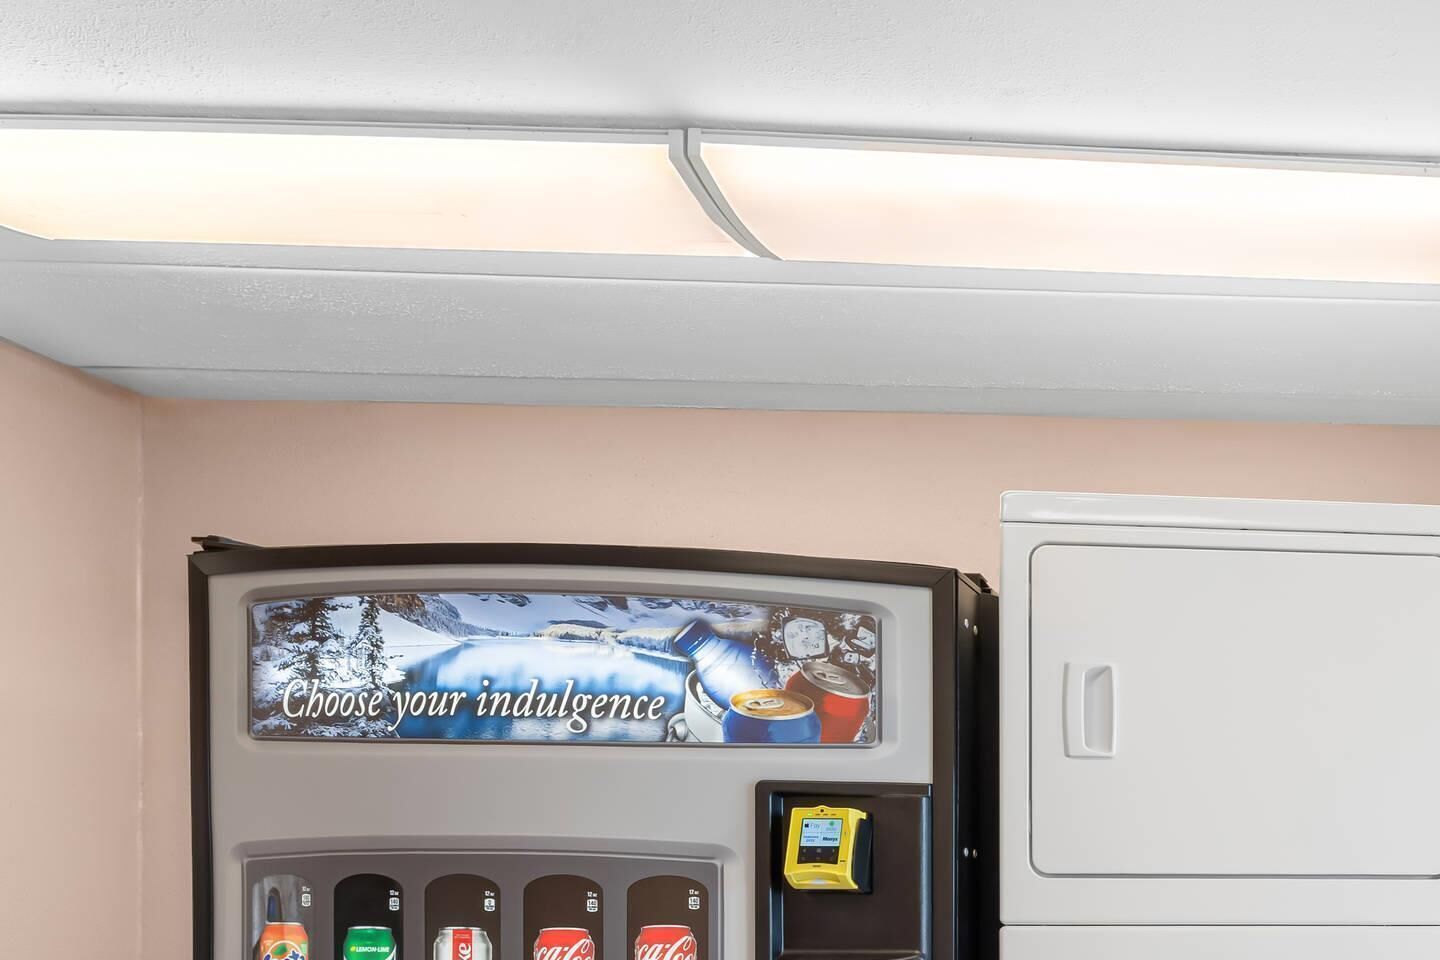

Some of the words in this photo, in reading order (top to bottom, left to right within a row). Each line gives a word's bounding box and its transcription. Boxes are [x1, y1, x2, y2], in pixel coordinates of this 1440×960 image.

[283, 678, 384, 718] Choose
[388, 690, 467, 732] your
[476, 678, 665, 733] indulgence
[356, 946, 390, 954] LEMON-LIME
